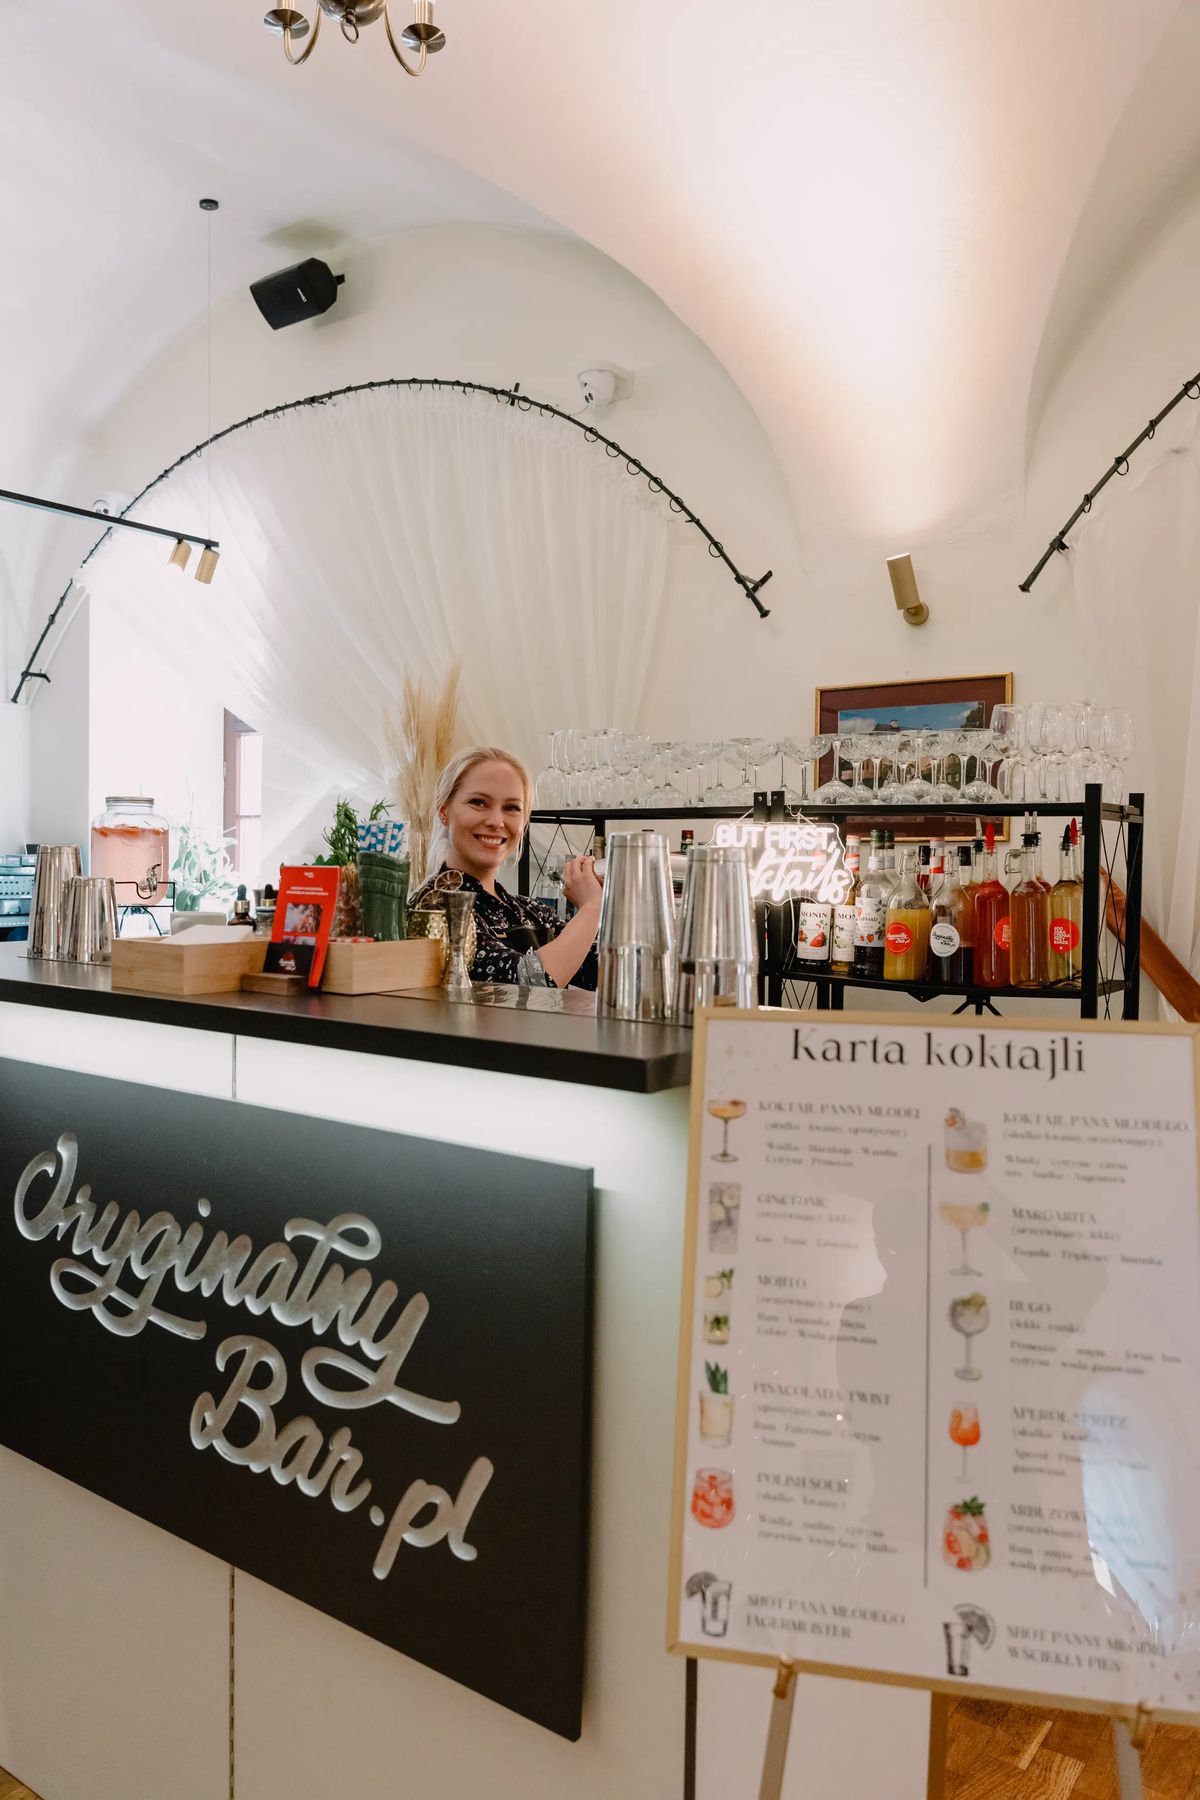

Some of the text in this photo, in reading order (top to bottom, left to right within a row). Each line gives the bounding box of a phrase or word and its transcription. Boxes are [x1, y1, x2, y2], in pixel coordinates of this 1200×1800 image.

[716, 824, 764, 848] BUT
[800, 911, 828, 919] MONIN
[791, 1027, 1086, 1081] Karta koktajli
[1011, 1206, 1098, 1225] MARGARITA
[14, 1132, 461, 1425] Oryginalny
[190, 1335, 494, 1581] Bar.pl
